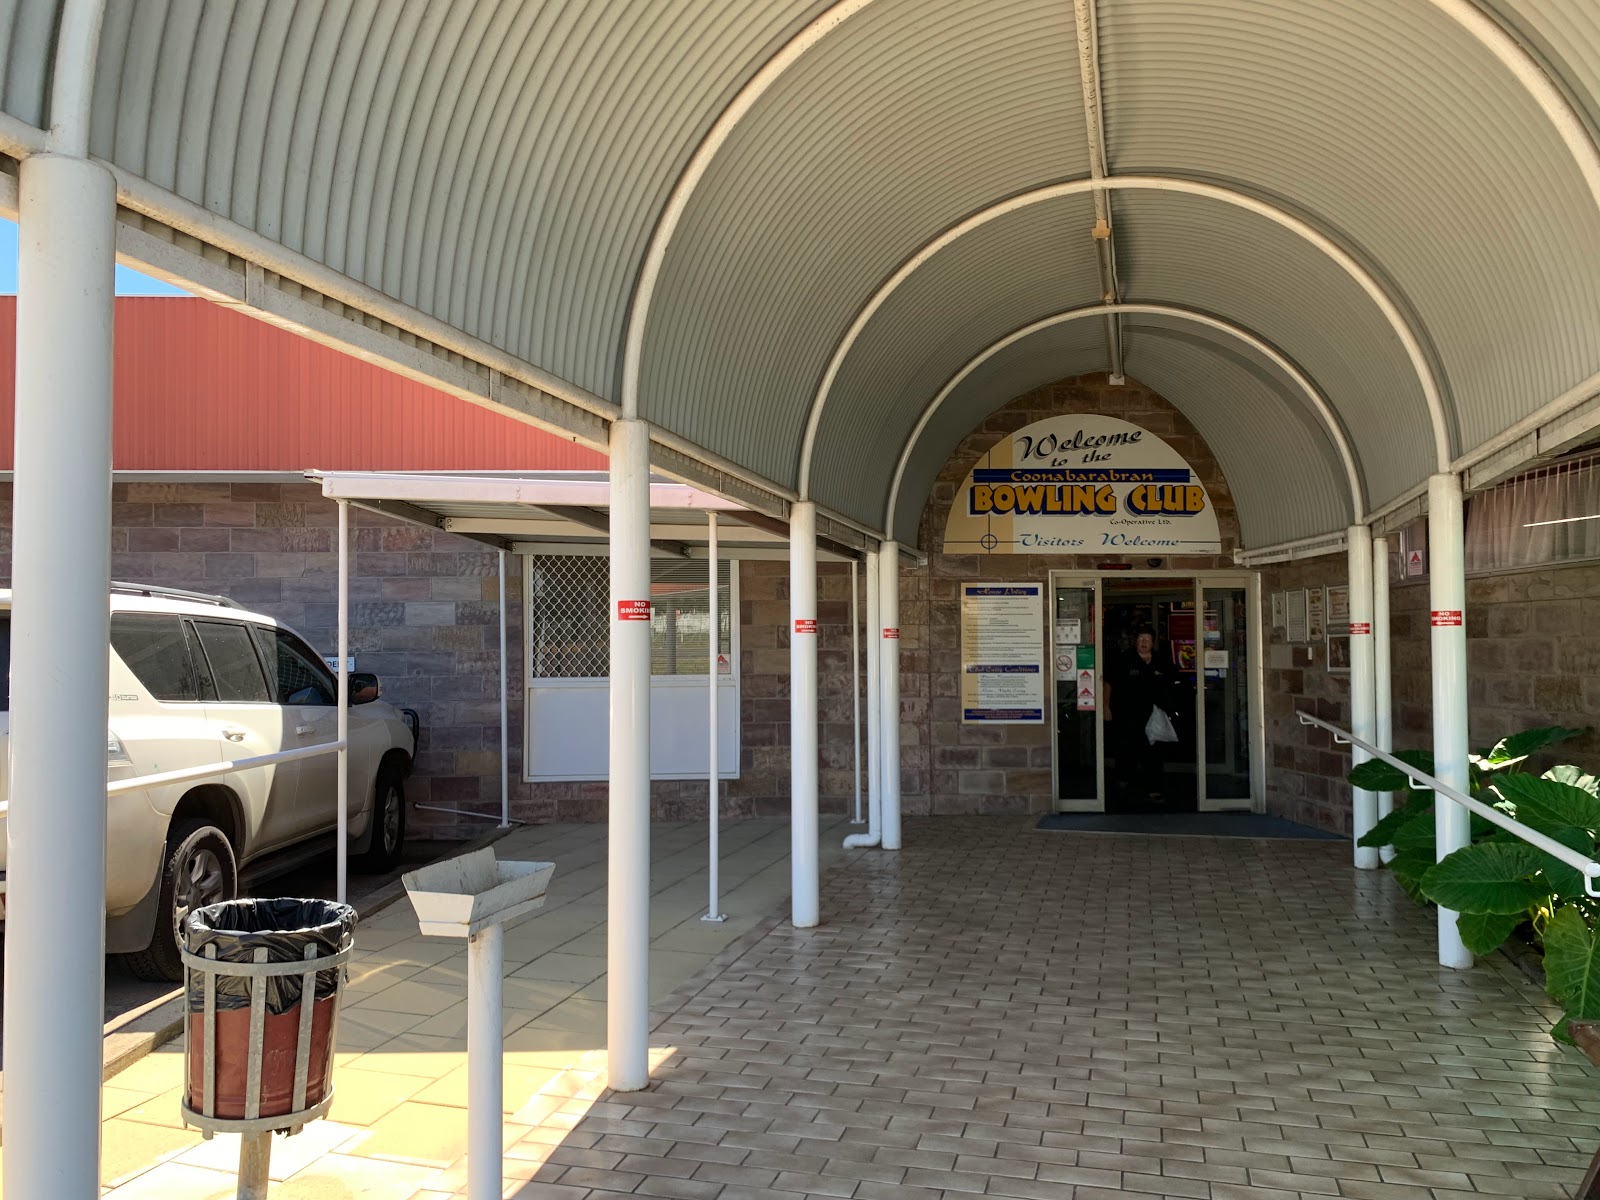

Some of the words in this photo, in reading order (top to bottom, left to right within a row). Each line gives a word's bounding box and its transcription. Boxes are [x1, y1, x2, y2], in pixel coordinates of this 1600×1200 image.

[1015, 429, 1143, 461] Welcome
[1050, 457, 1068, 468] to
[1082, 449, 1112, 465] the
[1010, 469, 1154, 482] Coonabarabran
[970, 484, 1117, 515] BOWLING
[1125, 483, 1206, 516] CLUB
[1109, 518, 1156, 526] Co-Operative
[1018, 533, 1085, 547] Visitors
[1100, 532, 1180, 547] Welcome
